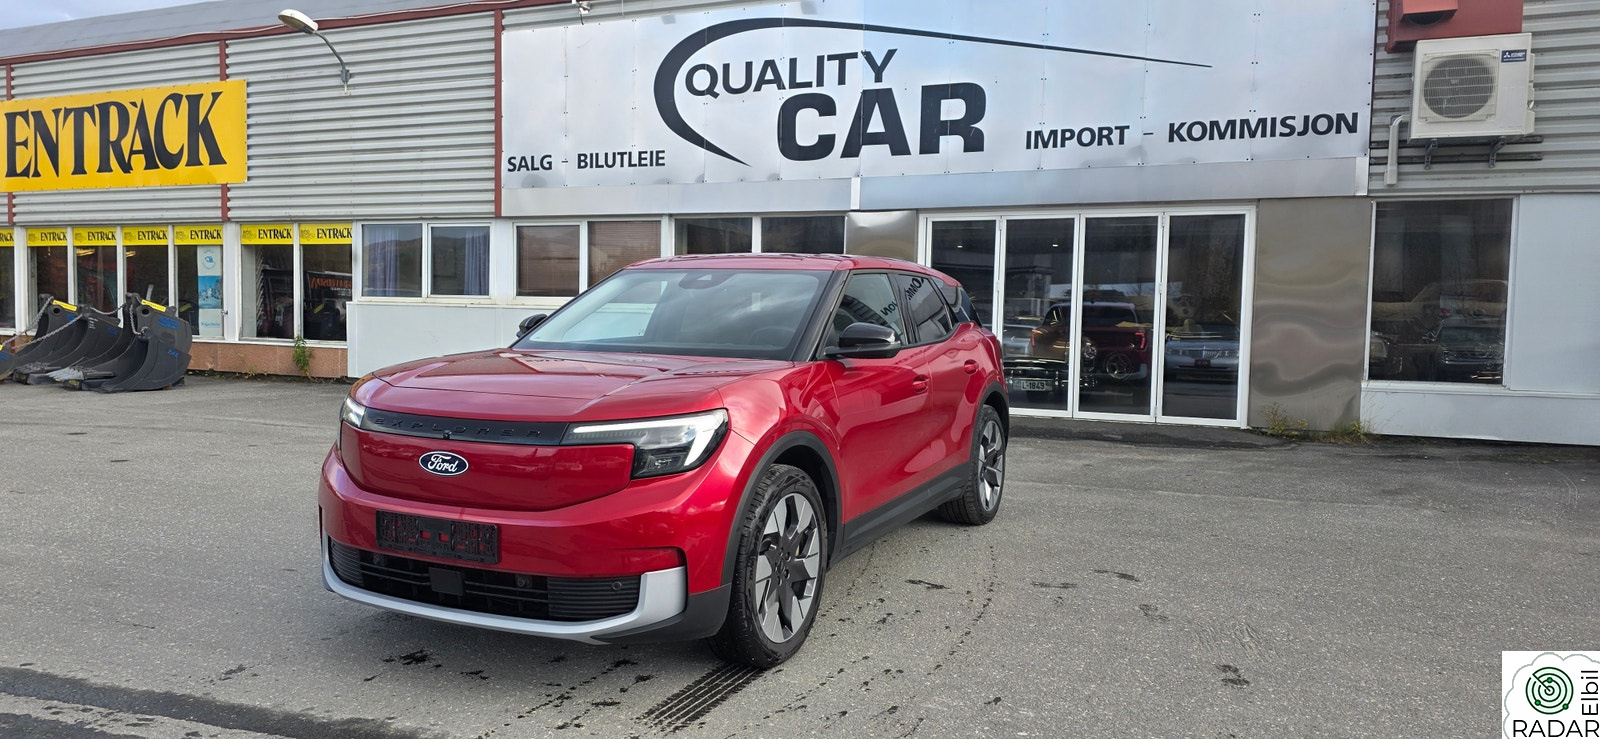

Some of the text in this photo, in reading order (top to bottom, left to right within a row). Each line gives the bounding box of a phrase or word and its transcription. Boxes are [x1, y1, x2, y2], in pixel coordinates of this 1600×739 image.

[685, 48, 898, 99] QUALITY
[777, 81, 987, 162] CAR
[1025, 124, 1130, 150] IMPORT
[1168, 112, 1359, 143] KOMMISJON
[4, 91, 228, 179] ENTRACK
[507, 154, 553, 173] SALG
[577, 150, 666, 170] BILUTLEIE
[40, 231, 67, 241] ENTRACK
[87, 230, 116, 241] ENTRACK
[137, 230, 167, 241] ENTRACK
[190, 229, 222, 240] ENTRACK
[258, 228, 292, 240] ENTRACK
[374, 417, 542, 438] EXPLORER
[427, 453, 459, 473] Ford
